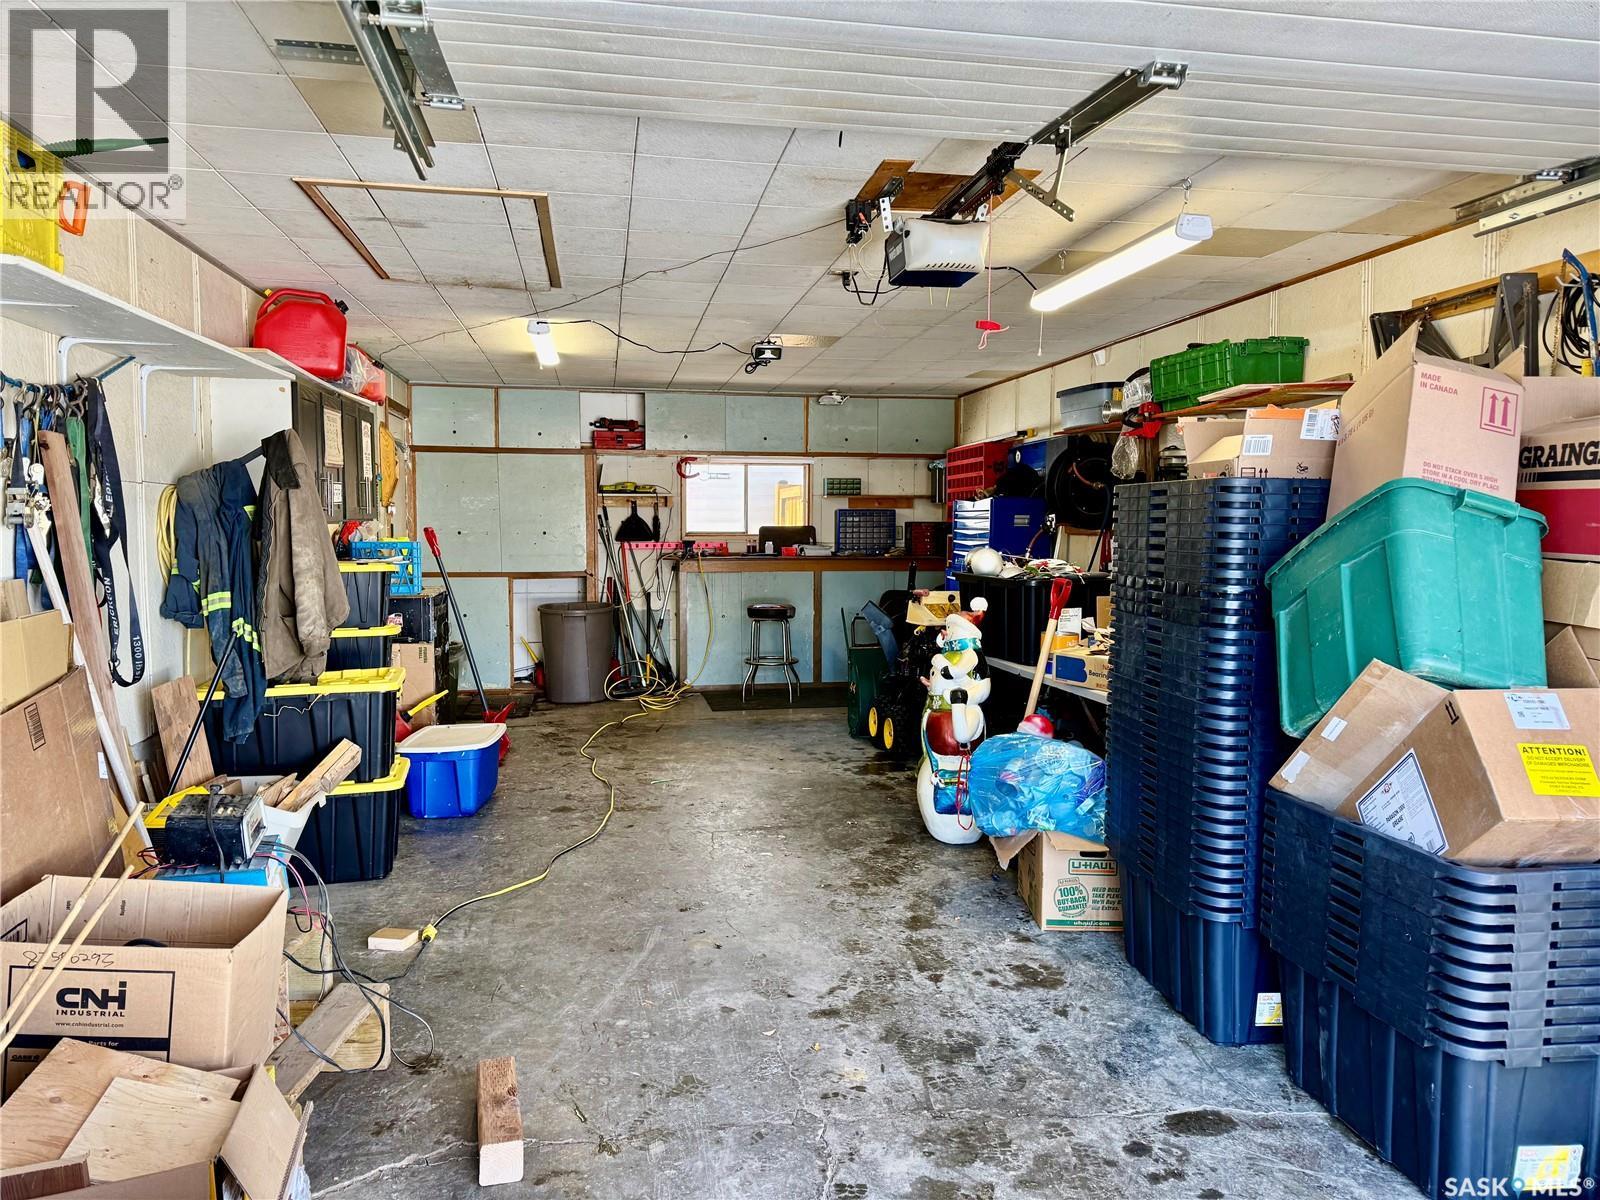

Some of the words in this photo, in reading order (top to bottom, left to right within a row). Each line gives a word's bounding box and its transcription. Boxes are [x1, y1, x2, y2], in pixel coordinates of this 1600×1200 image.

[1421, 372, 1442, 383] MADE
[1429, 383, 1458, 395] CANADA
[1519, 440, 1600, 469] GRAING
[1088, 670, 1108, 679] Bearin
[1522, 746, 1586, 756] ATTENTION!
[1072, 861, 1115, 869] U-HAUL
[1058, 885, 1083, 898] 100%
[56, 1009, 125, 1017] INDUSTRIAL
